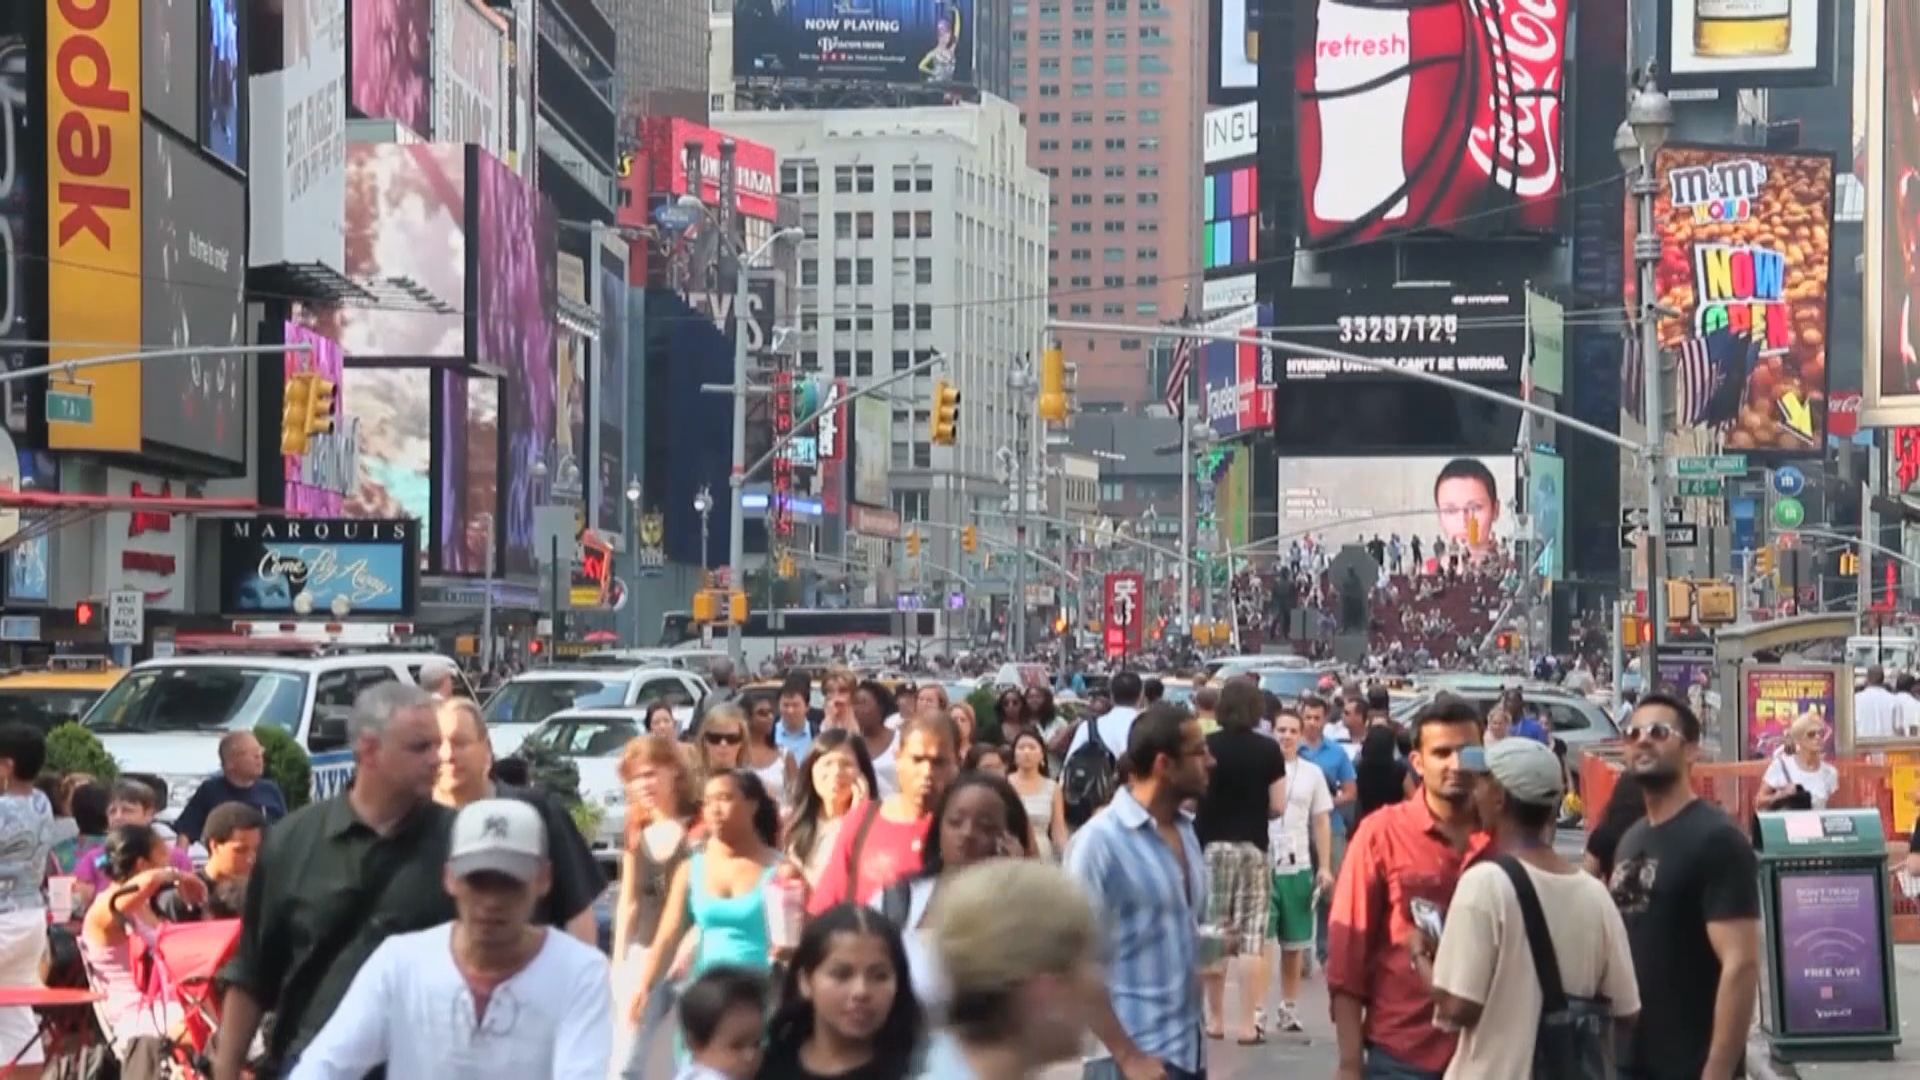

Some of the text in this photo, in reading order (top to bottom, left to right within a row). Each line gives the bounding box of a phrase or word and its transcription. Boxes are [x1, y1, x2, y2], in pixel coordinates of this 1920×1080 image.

[805, 18, 900, 32] NOW PLAYING
[1318, 33, 1406, 58] refresh
[1705, 249, 1783, 299] NOW
[1286, 358, 1340, 373] HYUNDAI
[1398, 356, 1436, 371] CAN'T
[1438, 356, 1455, 371] BE
[1457, 355, 1509, 371] WRONG.
[234, 522, 405, 539] MARQUIS
[258, 546, 393, 601] Come Fly Away
[1803, 967, 1832, 978] FREE
